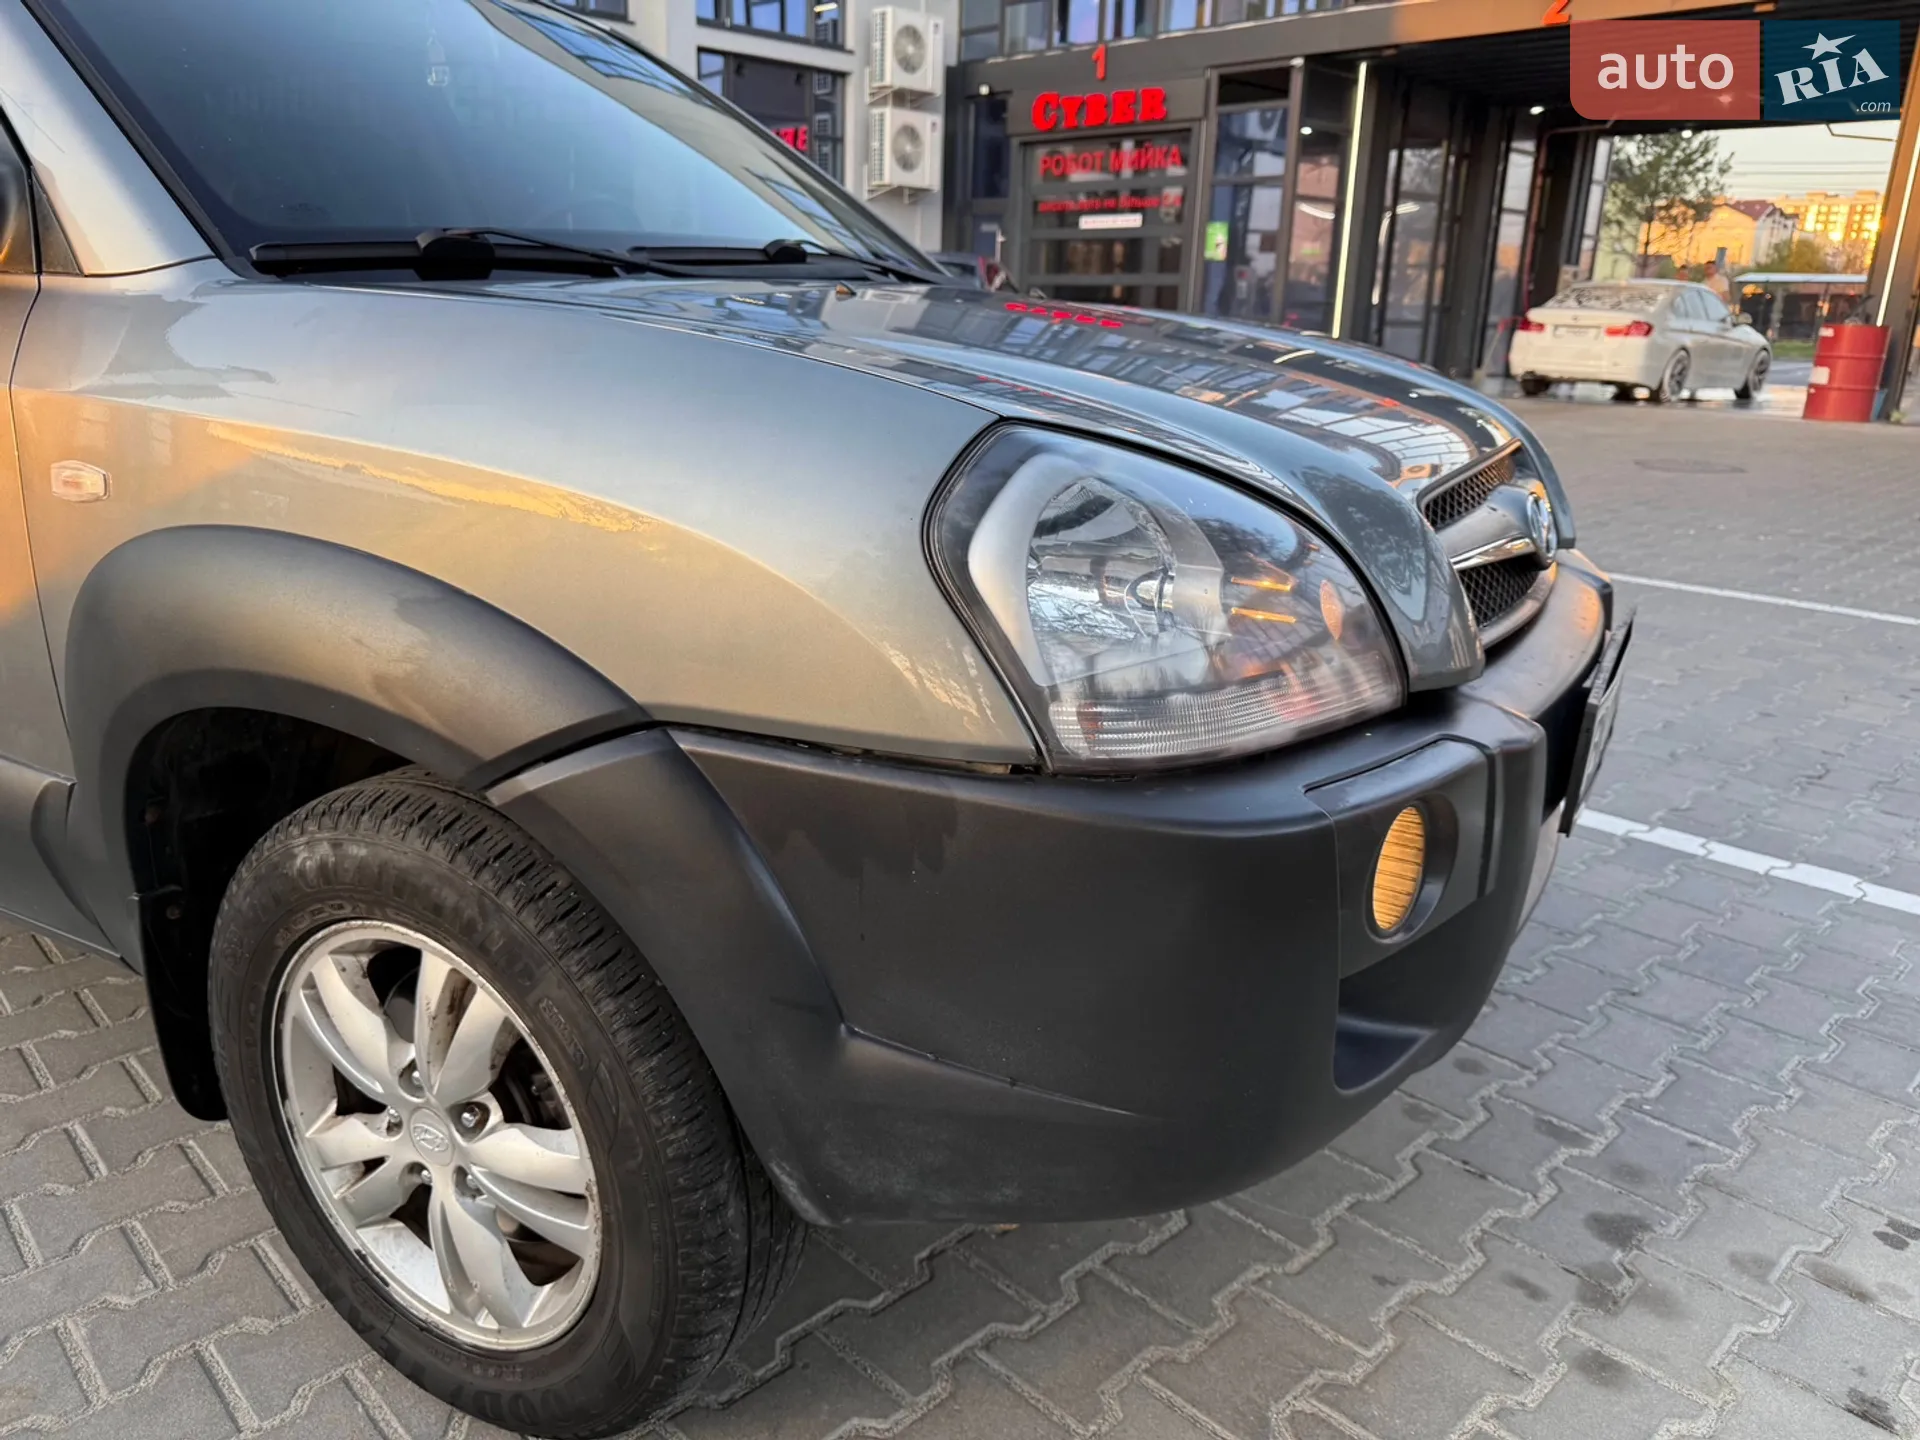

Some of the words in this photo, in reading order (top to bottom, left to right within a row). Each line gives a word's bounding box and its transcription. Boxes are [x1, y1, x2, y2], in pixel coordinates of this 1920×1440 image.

[1091, 43, 1108, 81] 1
[1040, 150, 1105, 177] РОБОТ
[1110, 142, 1183, 173] МИЙКА
